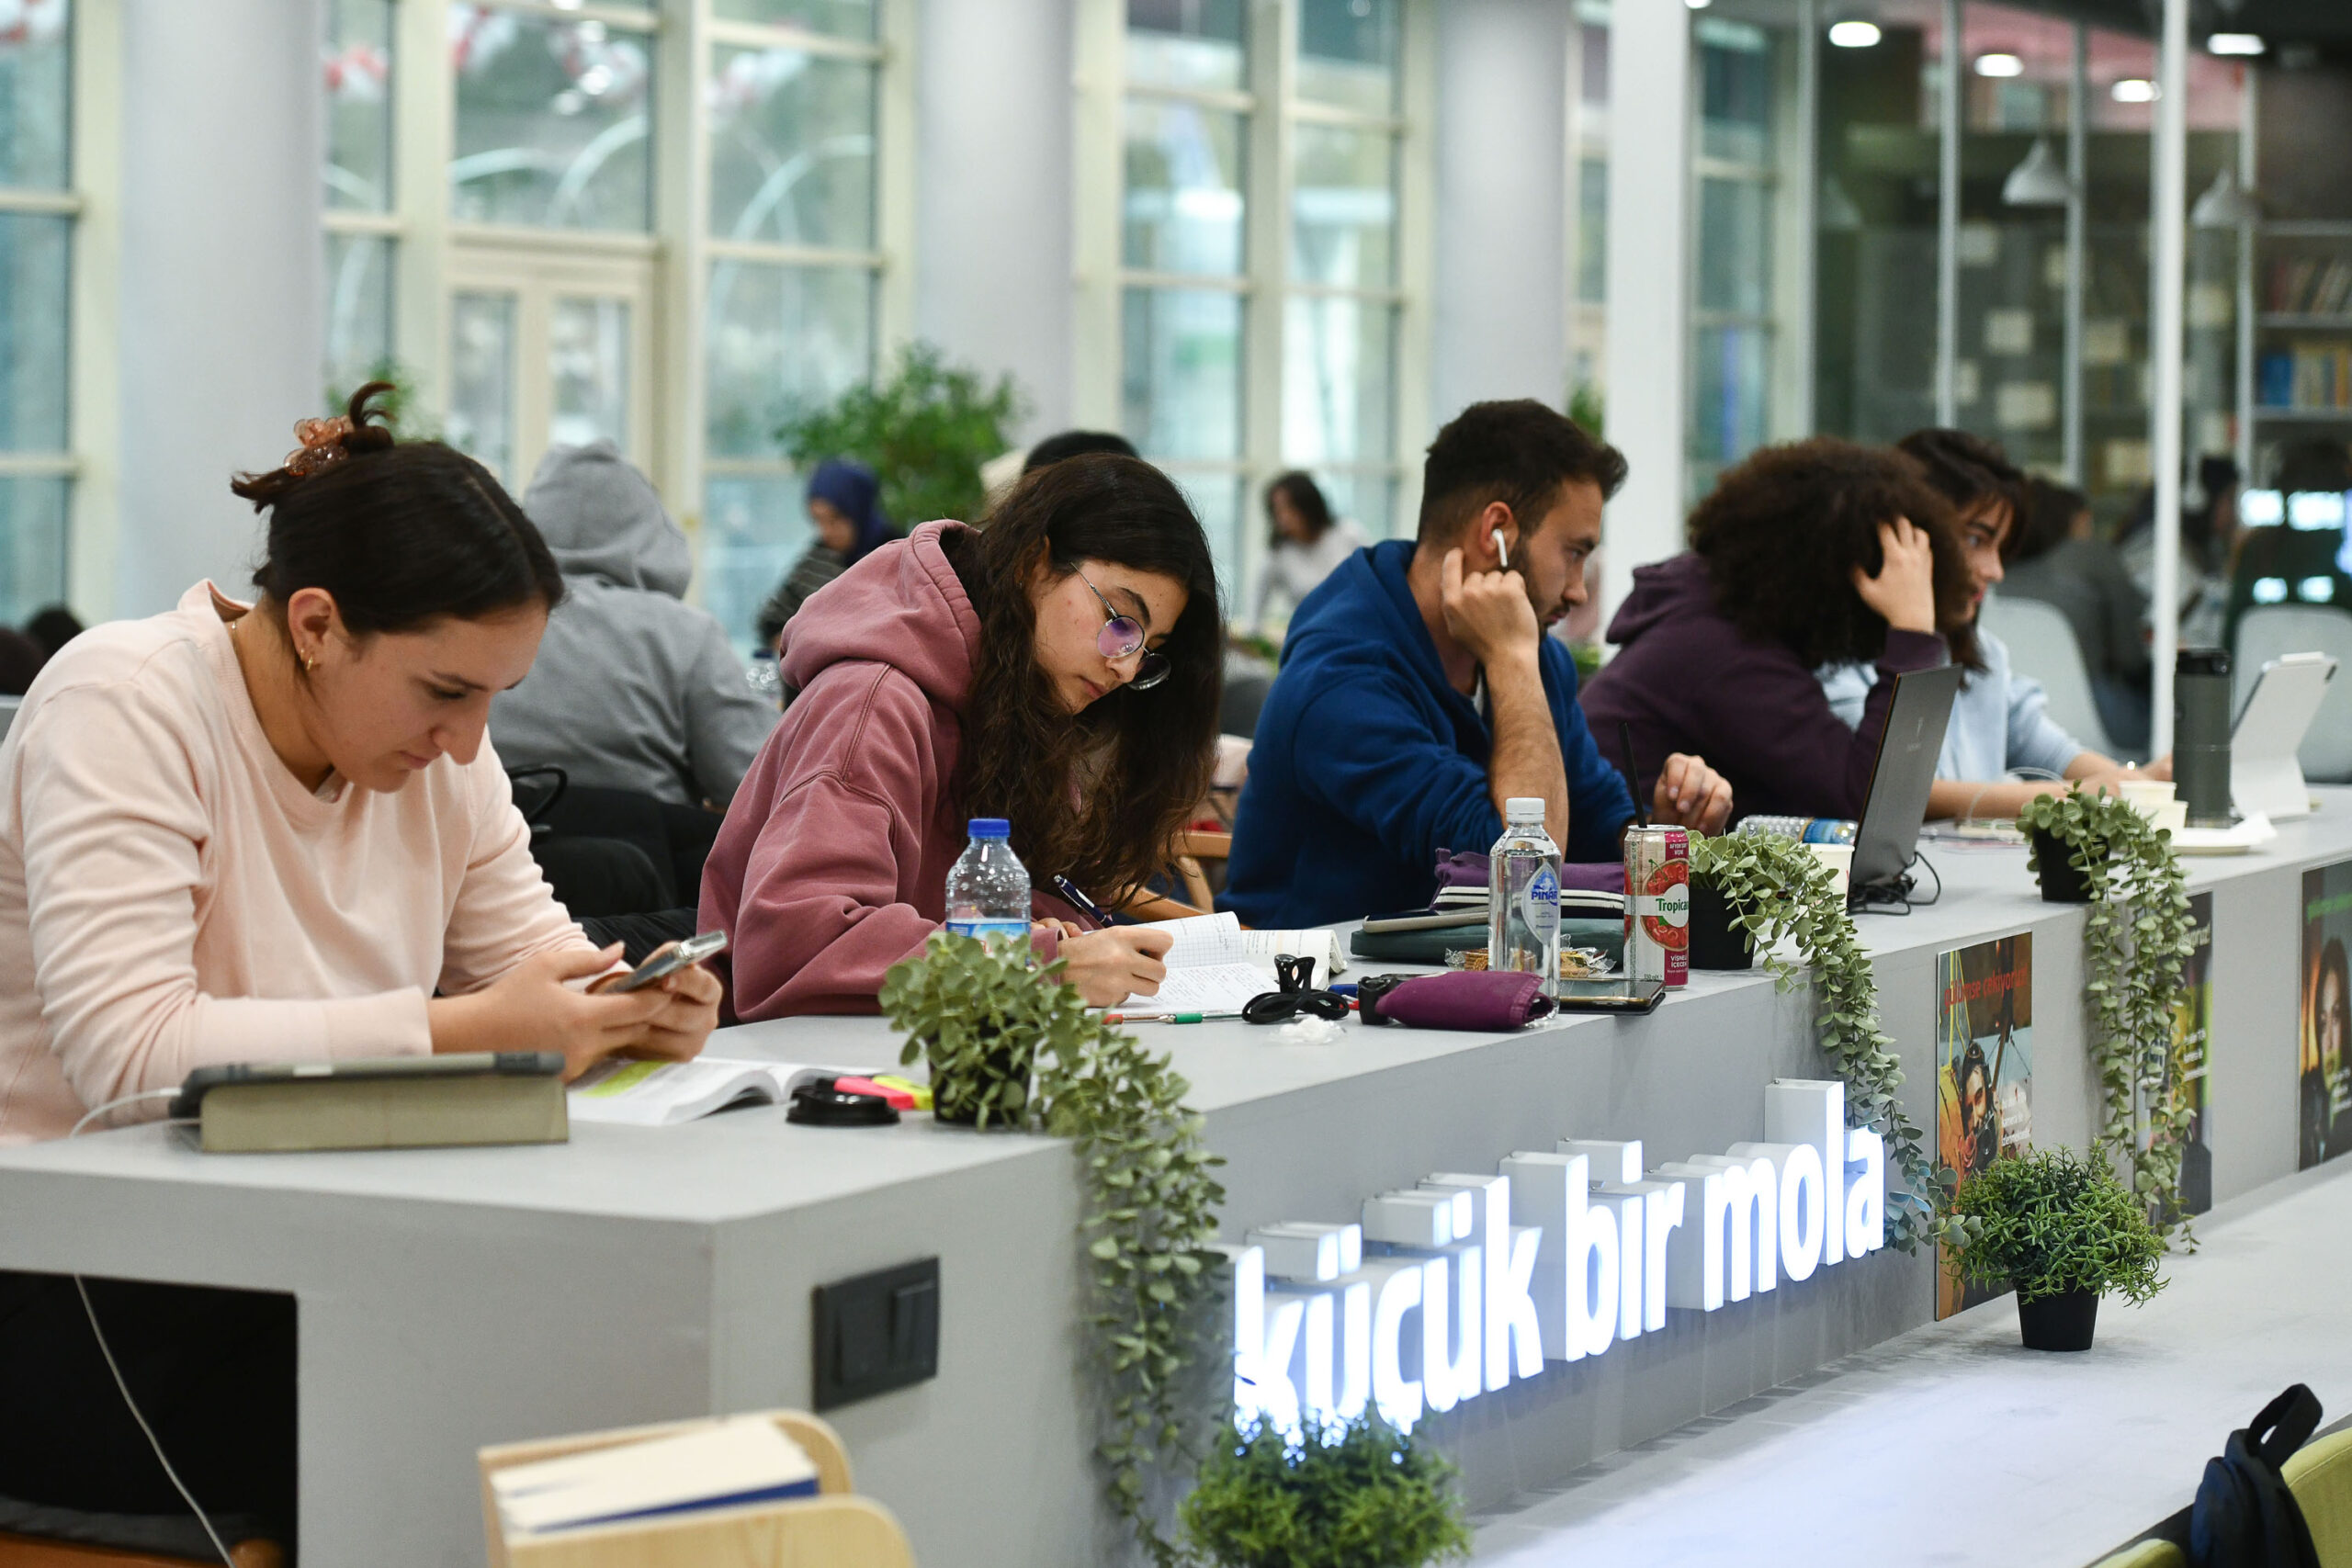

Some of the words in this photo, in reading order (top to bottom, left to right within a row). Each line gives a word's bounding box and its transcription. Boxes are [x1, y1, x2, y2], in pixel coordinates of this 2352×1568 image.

[1234, 1176, 1544, 1436] küçük
[1566, 1139, 1686, 1362] bir
[1703, 1080, 1884, 1312] mola
